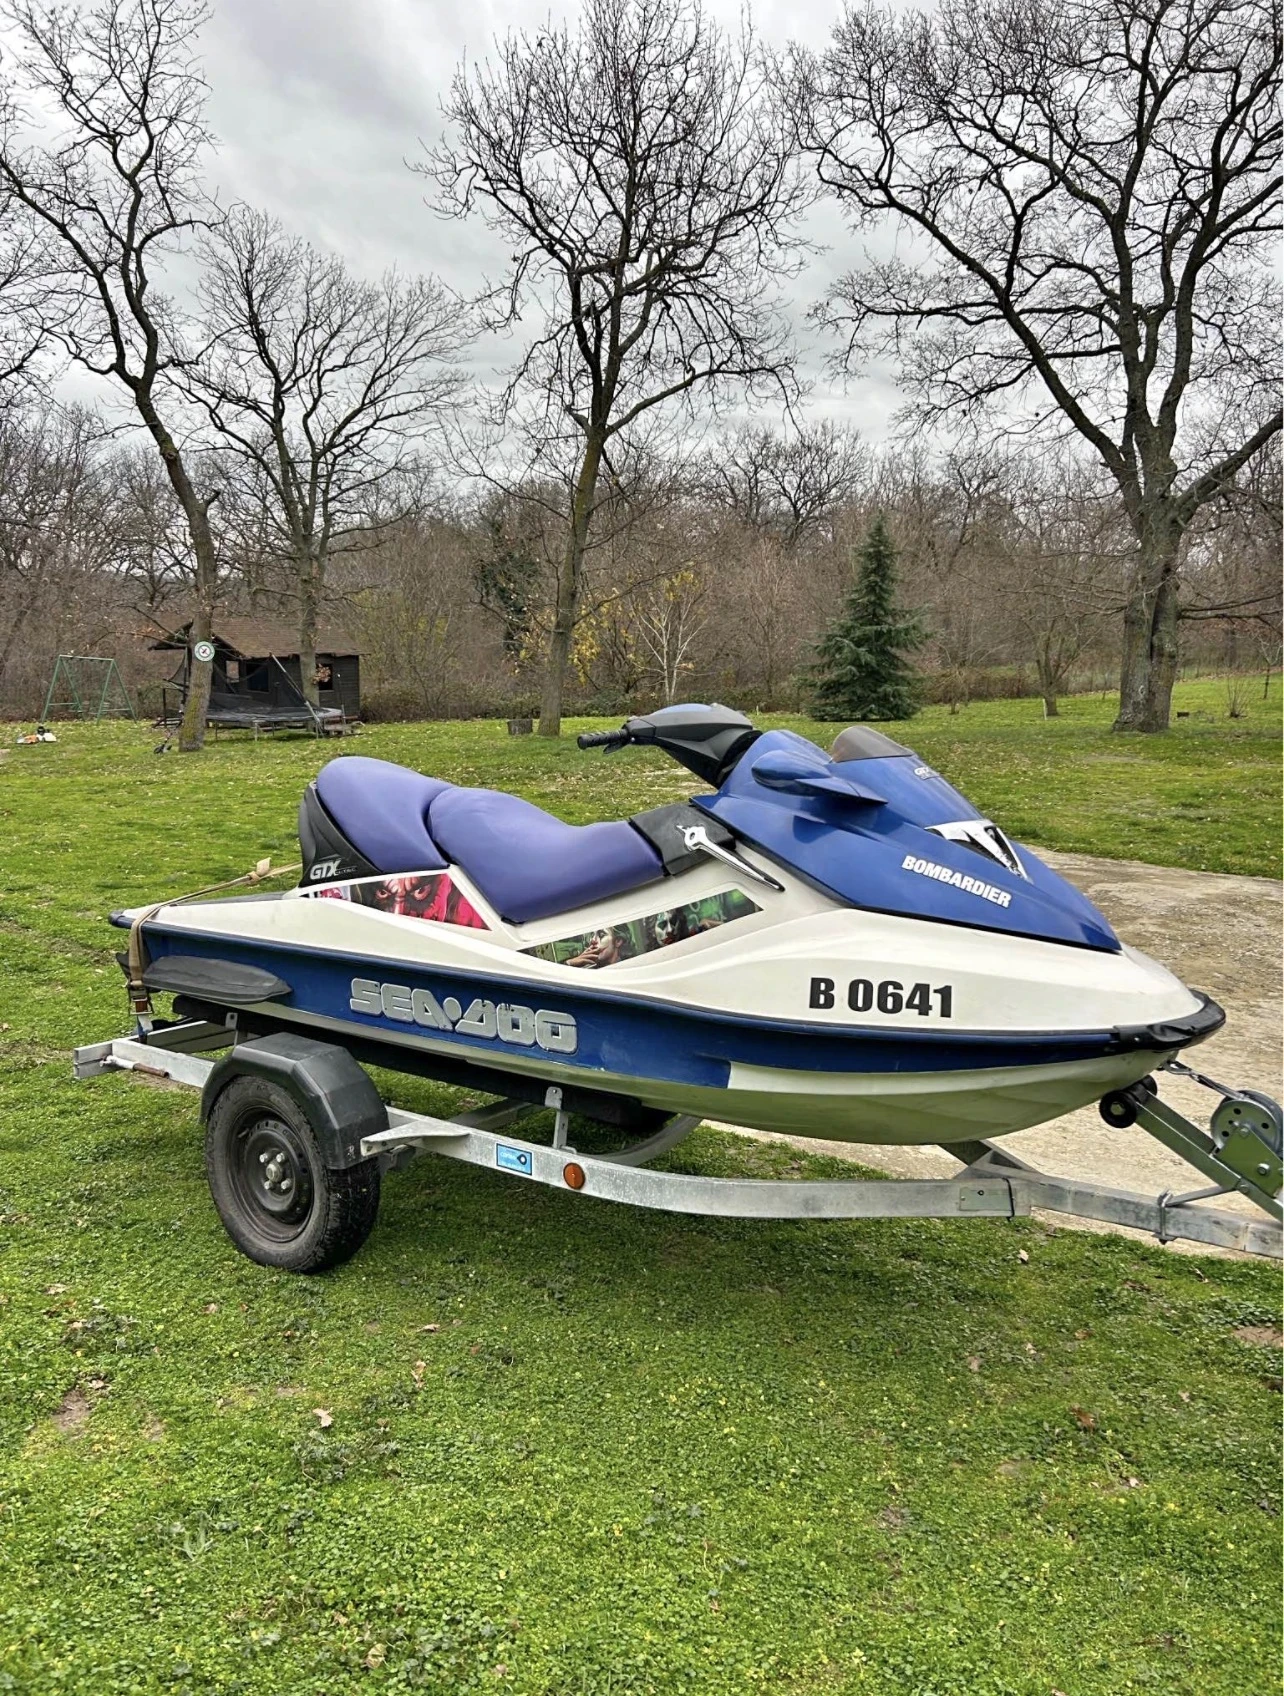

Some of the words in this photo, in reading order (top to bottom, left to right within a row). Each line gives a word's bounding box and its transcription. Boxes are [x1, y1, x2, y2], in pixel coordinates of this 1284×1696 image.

[310, 858, 342, 880] GTX
[901, 855, 1012, 908] BOMBARDIER
[809, 977, 835, 1010] B
[847, 978, 953, 1018] 0641
